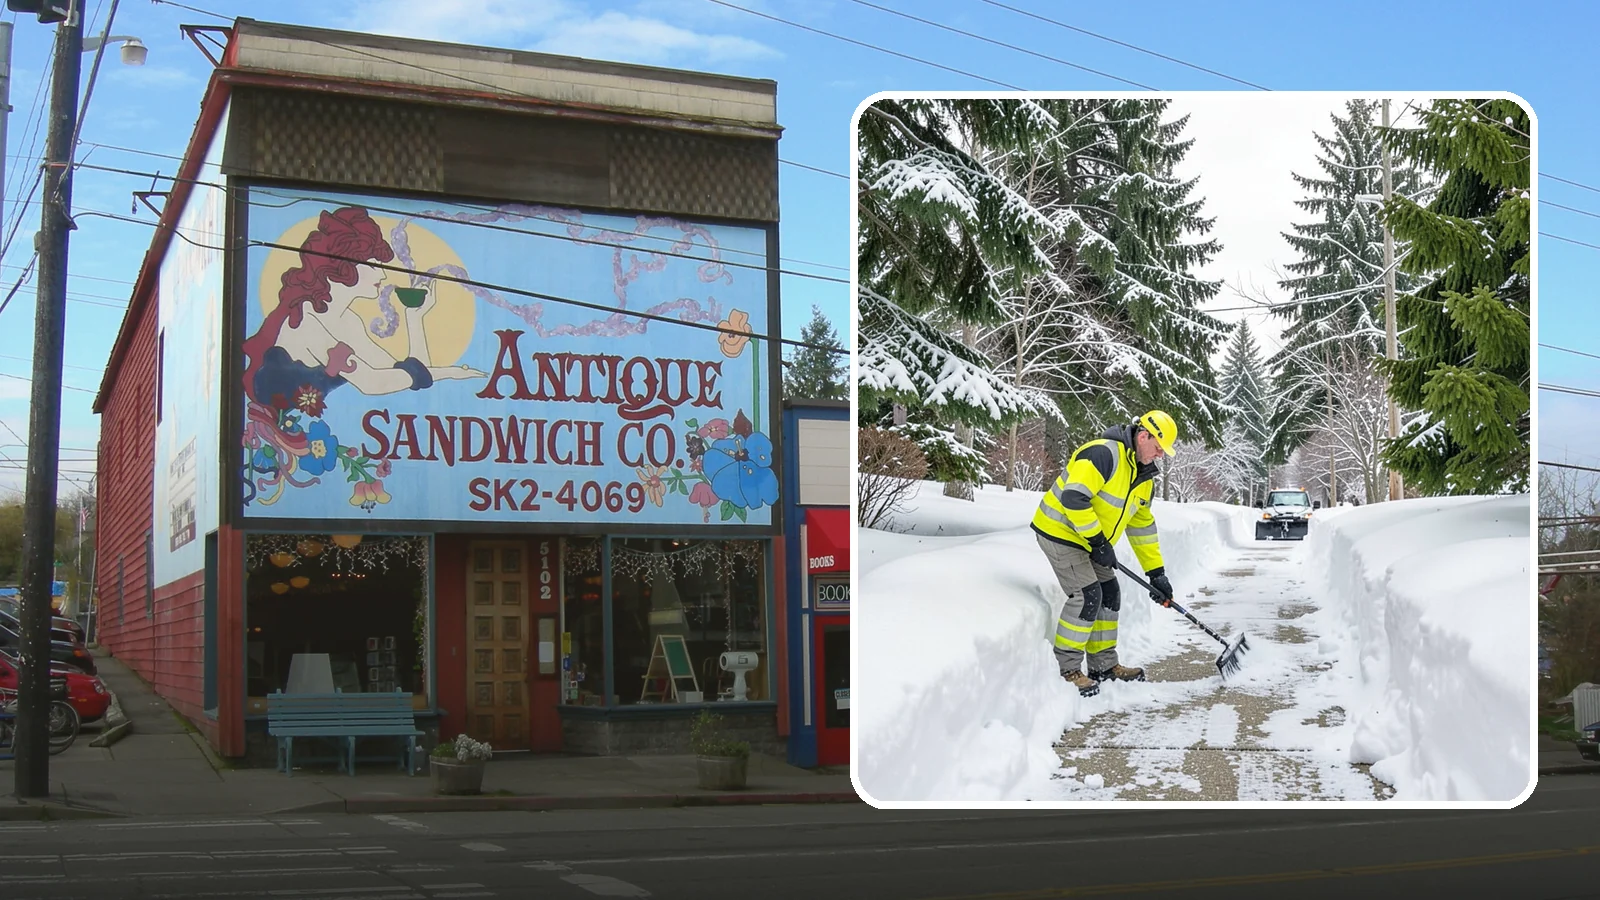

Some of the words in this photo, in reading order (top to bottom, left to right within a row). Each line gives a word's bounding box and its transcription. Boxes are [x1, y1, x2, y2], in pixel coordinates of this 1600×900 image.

[361, 408, 604, 467] SANDWICH
[617, 420, 686, 469] CO.
[469, 477, 645, 513] SK2-4069
[539, 541, 552, 600] 5102
[809, 555, 835, 569] BOOKS
